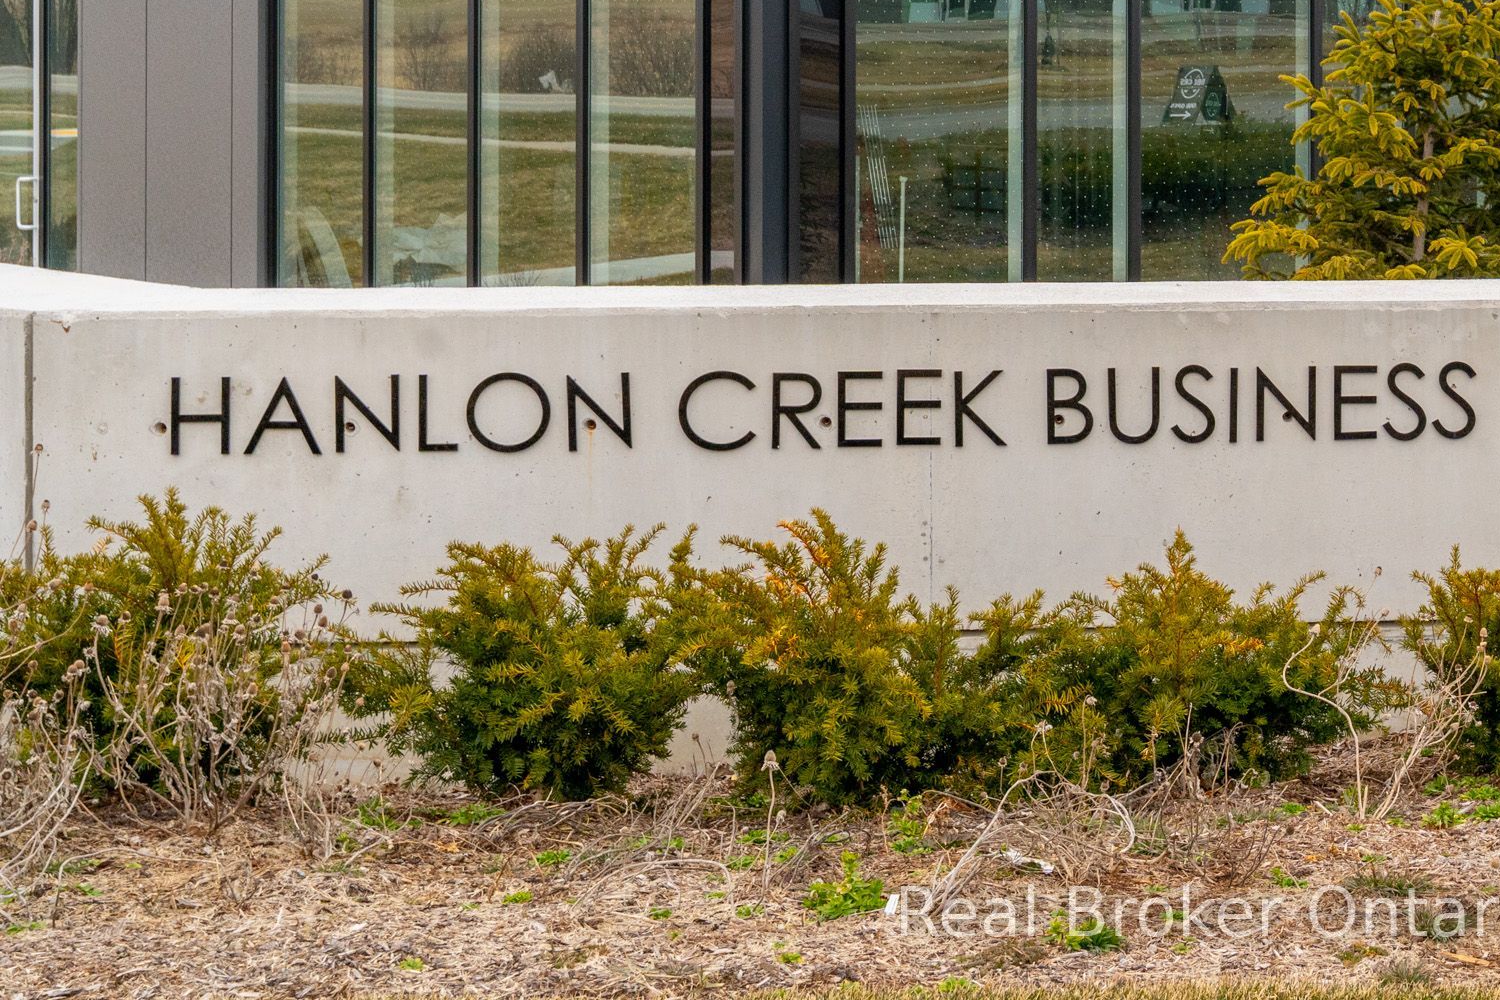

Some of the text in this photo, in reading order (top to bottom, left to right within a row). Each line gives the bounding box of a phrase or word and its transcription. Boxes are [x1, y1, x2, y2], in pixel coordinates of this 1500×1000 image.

[169, 372, 633, 457] HANLON
[678, 368, 1008, 452] CREEK
[1045, 361, 1478, 444] BUSINESS
